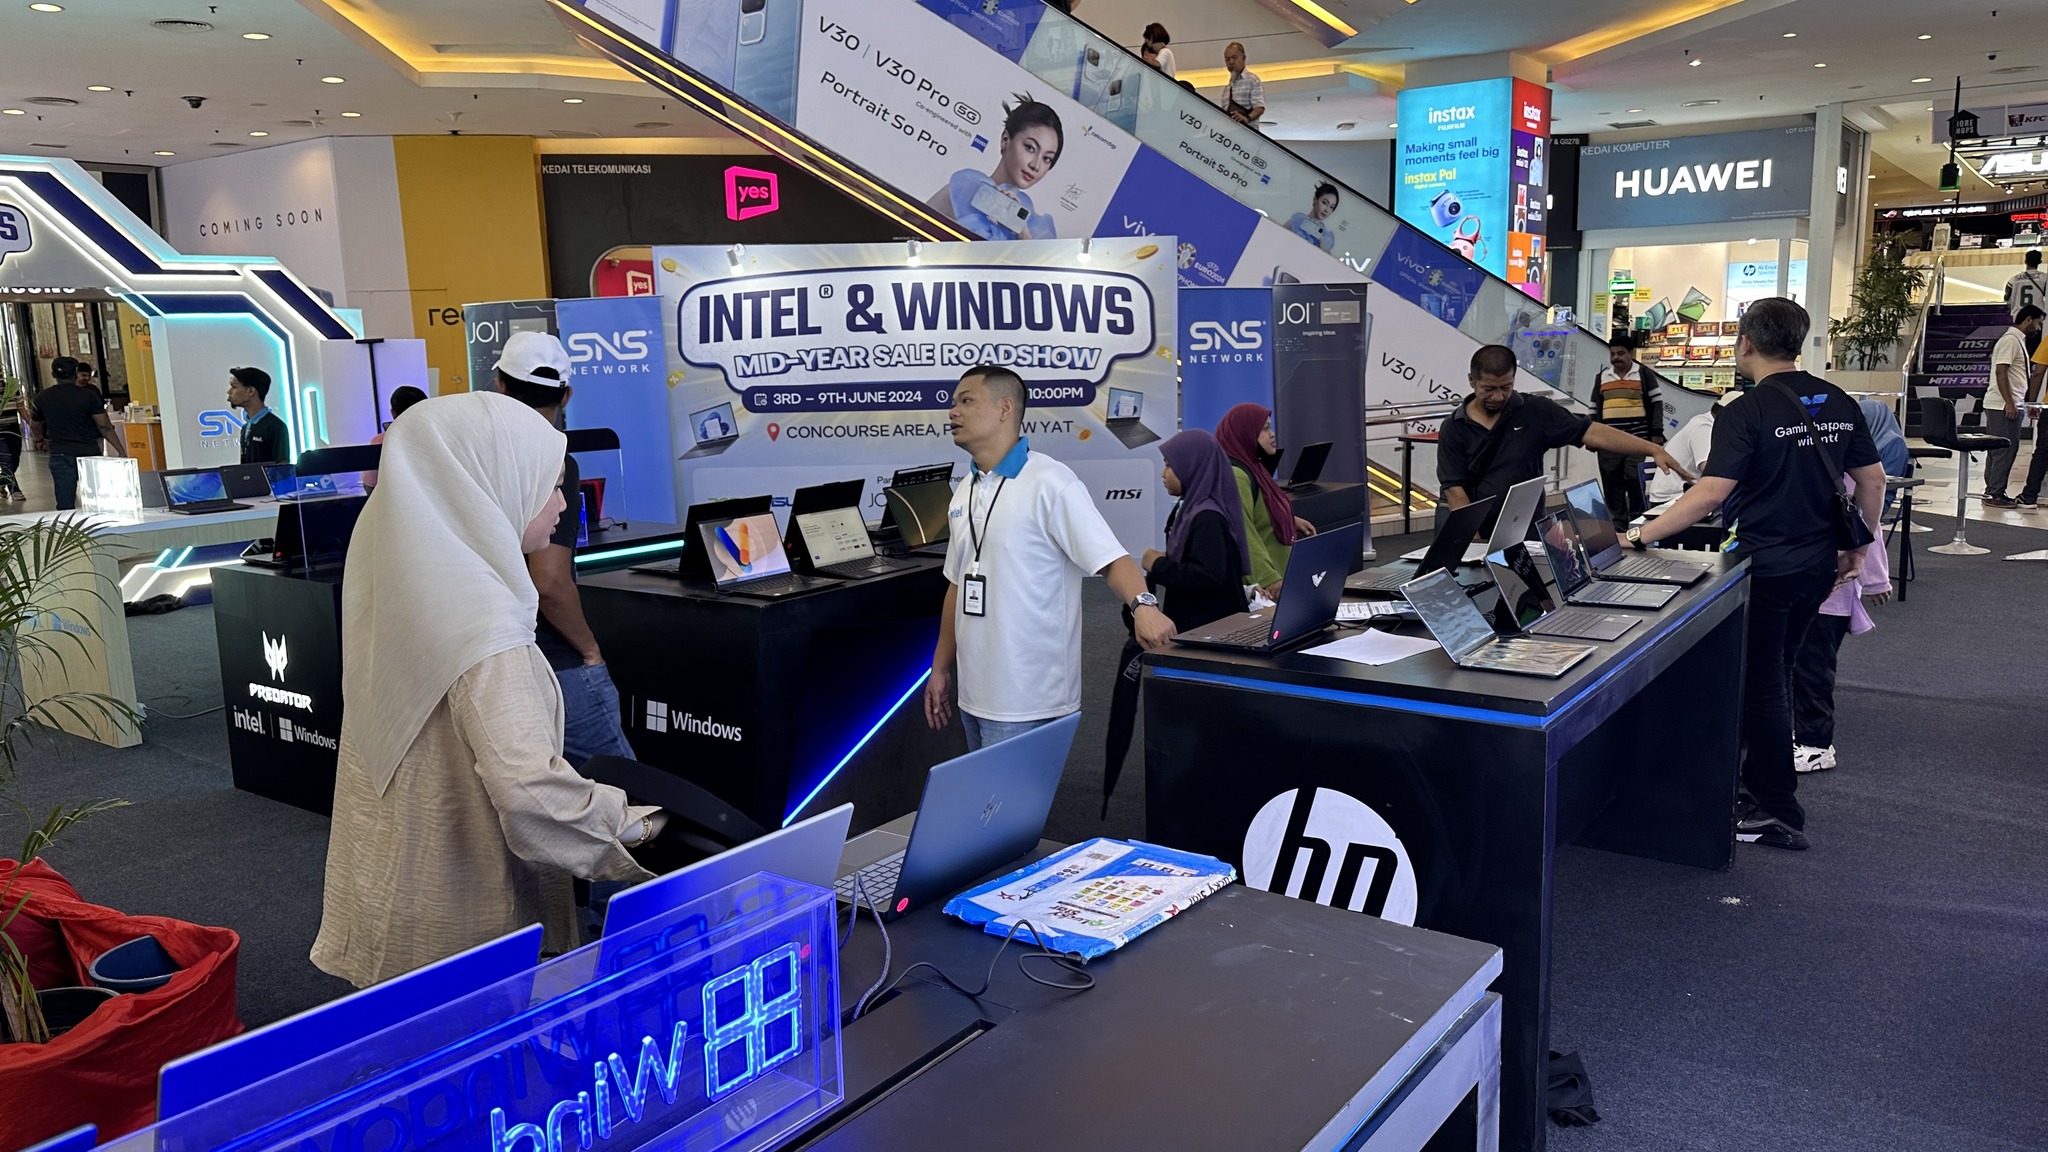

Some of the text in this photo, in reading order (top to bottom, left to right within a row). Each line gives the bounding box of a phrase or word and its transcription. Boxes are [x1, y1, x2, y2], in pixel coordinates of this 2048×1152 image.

[819, 16, 978, 123] V30 V30 Pro 5G
[820, 71, 949, 157] Portrait So Pro
[915, 100, 959, 131] Co-engineered
[1428, 105, 1476, 124] instax
[2024, 115, 2048, 123] KFC
[1179, 110, 1203, 130] V30
[1209, 128, 1233, 149] V30
[1231, 143, 1250, 161] Pro
[1955, 127, 1975, 135] HOPS
[1405, 137, 1478, 156] Making small
[1580, 140, 1671, 156] KEDAI KOMPUTER
[1179, 141, 1248, 188] Portrait So Pro
[1405, 146, 1500, 166] moments feel big
[542, 164, 652, 175] KEDAI TELEKOMUNIKASI
[1405, 167, 1457, 185] instax Pal
[1614, 158, 1772, 199] HUAWEI
[738, 185, 769, 203] yes
[199, 208, 323, 237] COMING SOON
[1194, 261, 1226, 284] EURO2024
[1397, 253, 1425, 274] vivo
[632, 280, 649, 292] yes
[2020, 285, 2034, 308] 6
[846, 283, 888, 335] &
[891, 281, 1135, 335] WINDOWS
[1278, 302, 1310, 325] JOI
[469, 321, 499, 345] JOI
[1189, 320, 1263, 351] SNS
[1669, 324, 1739, 334] SALE SALE SAL
[568, 329, 649, 363] SNS
[1651, 335, 1666, 344] ALE
[1958, 340, 1990, 349] msi
[734, 343, 1102, 378] MID-YEAR SALE ROADSHOW
[1189, 353, 1264, 364] NETWORK
[1641, 353, 1660, 361] HUAW
[1663, 348, 1735, 358] SALE SALE SAL
[569, 363, 650, 376] NETWORK
[1381, 352, 1416, 381] V30
[1936, 363, 1991, 372] INNOVATI
[1929, 376, 1991, 385] WITH STYL
[773, 393, 802, 405] 3RD
[819, 392, 847, 404] 9TH
[848, 391, 888, 404] JUNE
[888, 390, 923, 403] 2024
[1028, 386, 1084, 400] 10:00PM
[198, 408, 247, 437] SN
[786, 424, 890, 439] CONCOURSE
[892, 424, 940, 438] AREA,
[1039, 420, 1074, 433] YAT
[200, 438, 241, 449] NETW
[1797, 435, 1815, 447] wit
[868, 493, 887, 508] JO
[1105, 488, 1143, 500] msi
[62, 619, 91, 637] Windows
[249, 682, 313, 713] PREDATOR
[233, 705, 337, 750] intel. Windows
[671, 710, 742, 742] Windows
